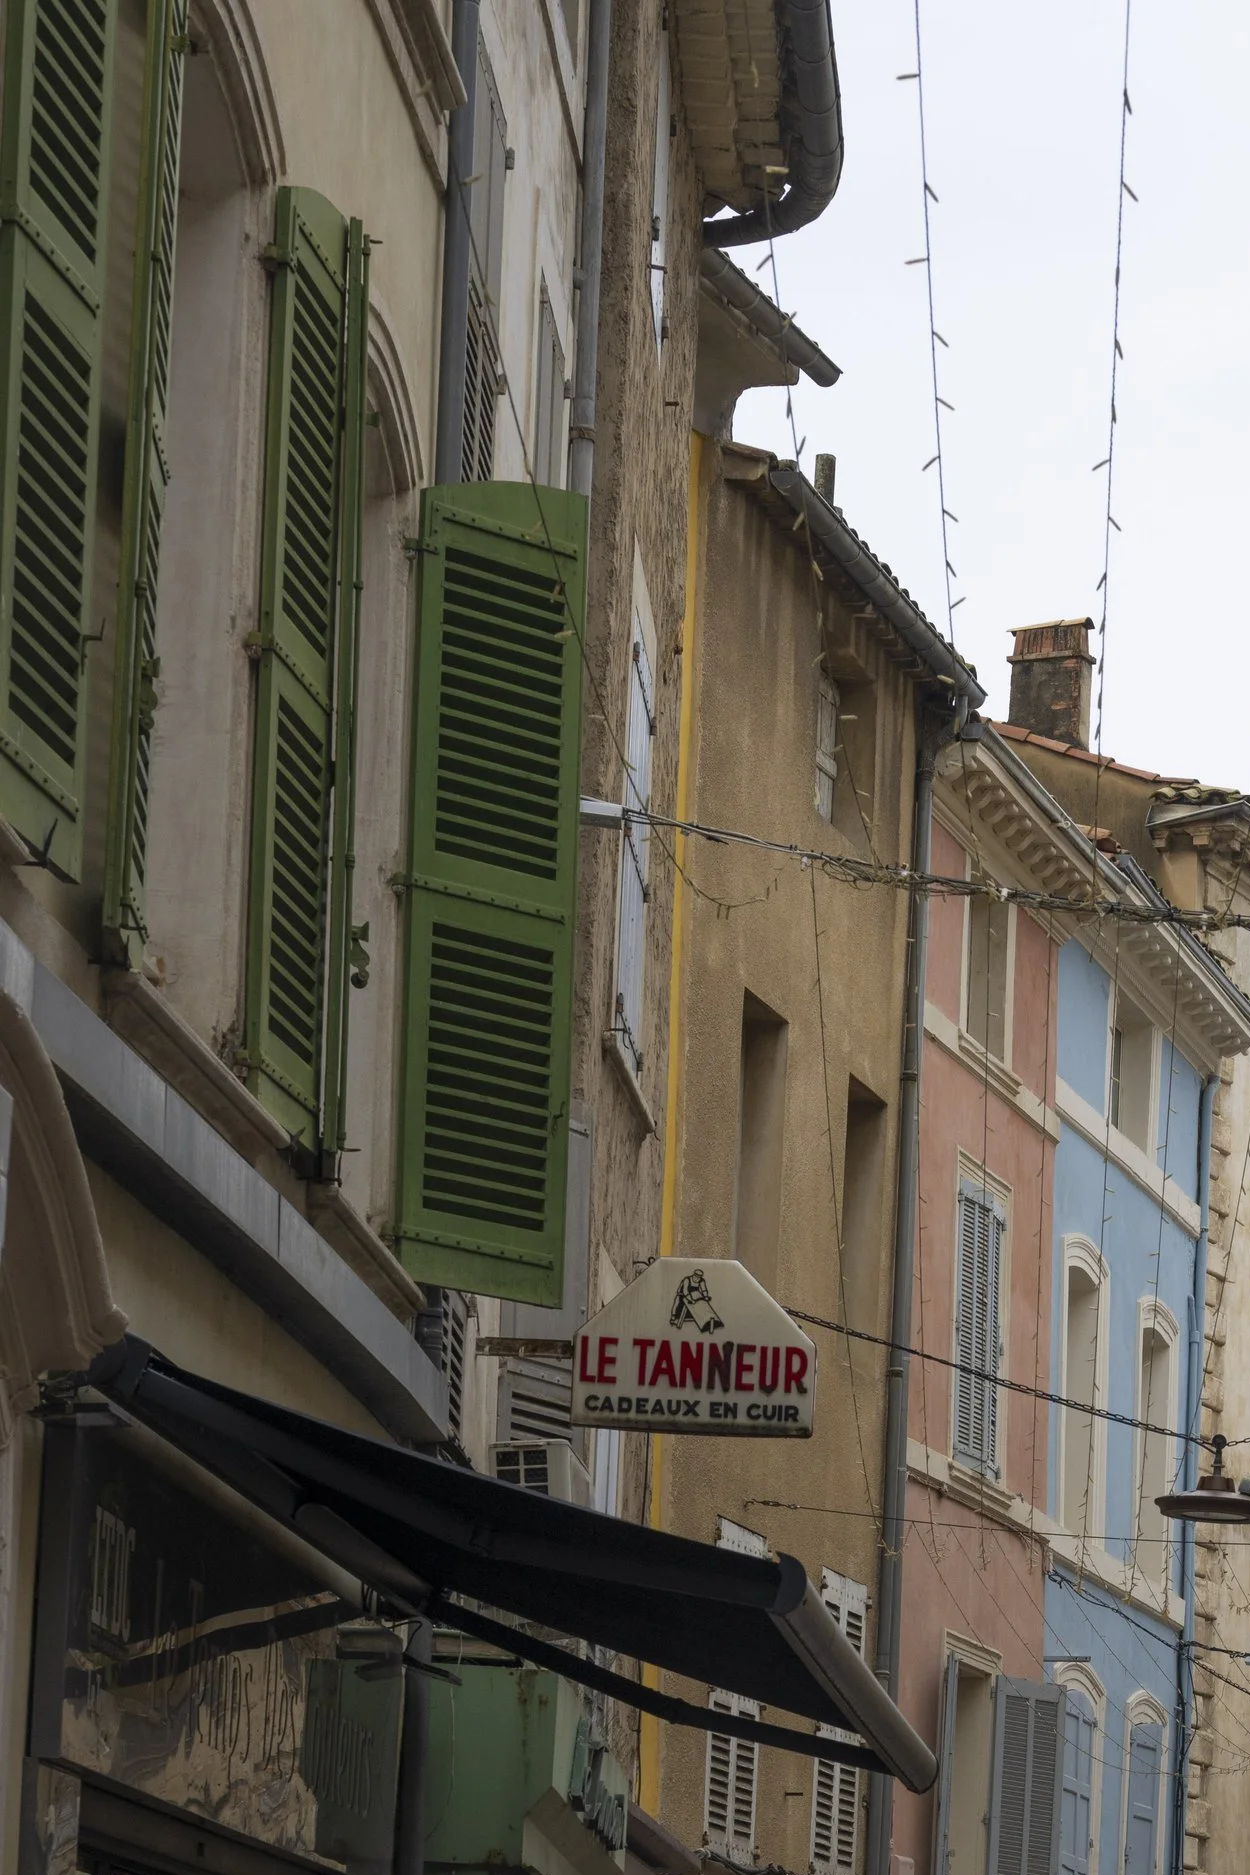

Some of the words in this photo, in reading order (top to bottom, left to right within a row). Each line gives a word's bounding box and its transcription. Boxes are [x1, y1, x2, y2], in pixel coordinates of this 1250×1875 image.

[579, 1335, 618, 1384] LE
[632, 1338, 808, 1394] TANNEUR
[584, 1395, 700, 1418] CADEAUX
[708, 1402, 738, 1419] EN
[746, 1403, 800, 1423] CUIR
